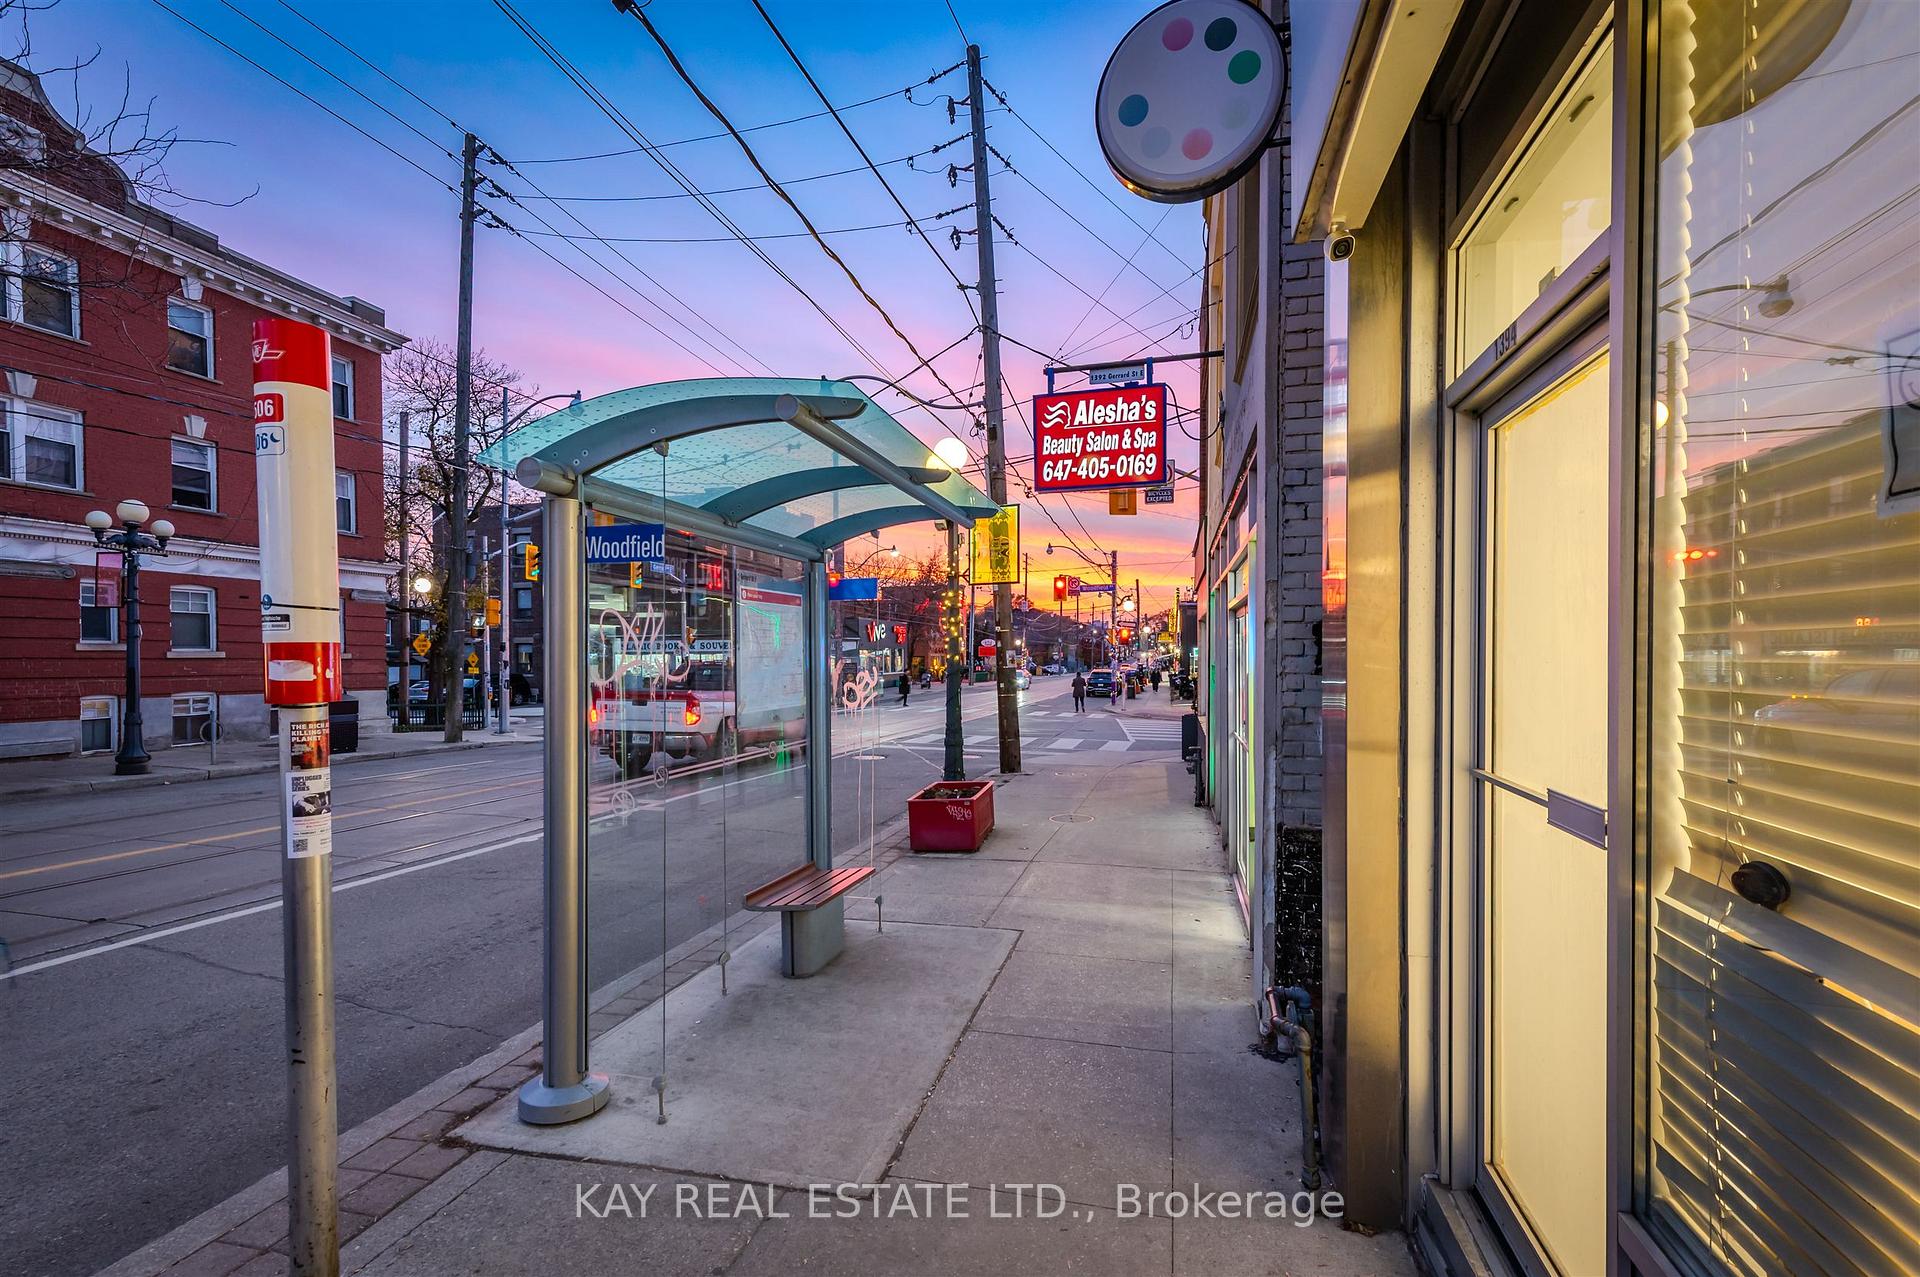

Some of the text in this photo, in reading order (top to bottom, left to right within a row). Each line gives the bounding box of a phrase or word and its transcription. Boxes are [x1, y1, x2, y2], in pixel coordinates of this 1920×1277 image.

[1495, 323, 1517, 361] 1394
[1090, 369, 1144, 381] 1392 Gerrard St E
[1074, 395, 1157, 426] Alesha's
[1042, 427, 1157, 458] Beauty Salon & Spa
[1042, 453, 1157, 482] 647-405-0169
[585, 534, 665, 559] Woodfield
[699, 641, 729, 650] SOUVE
